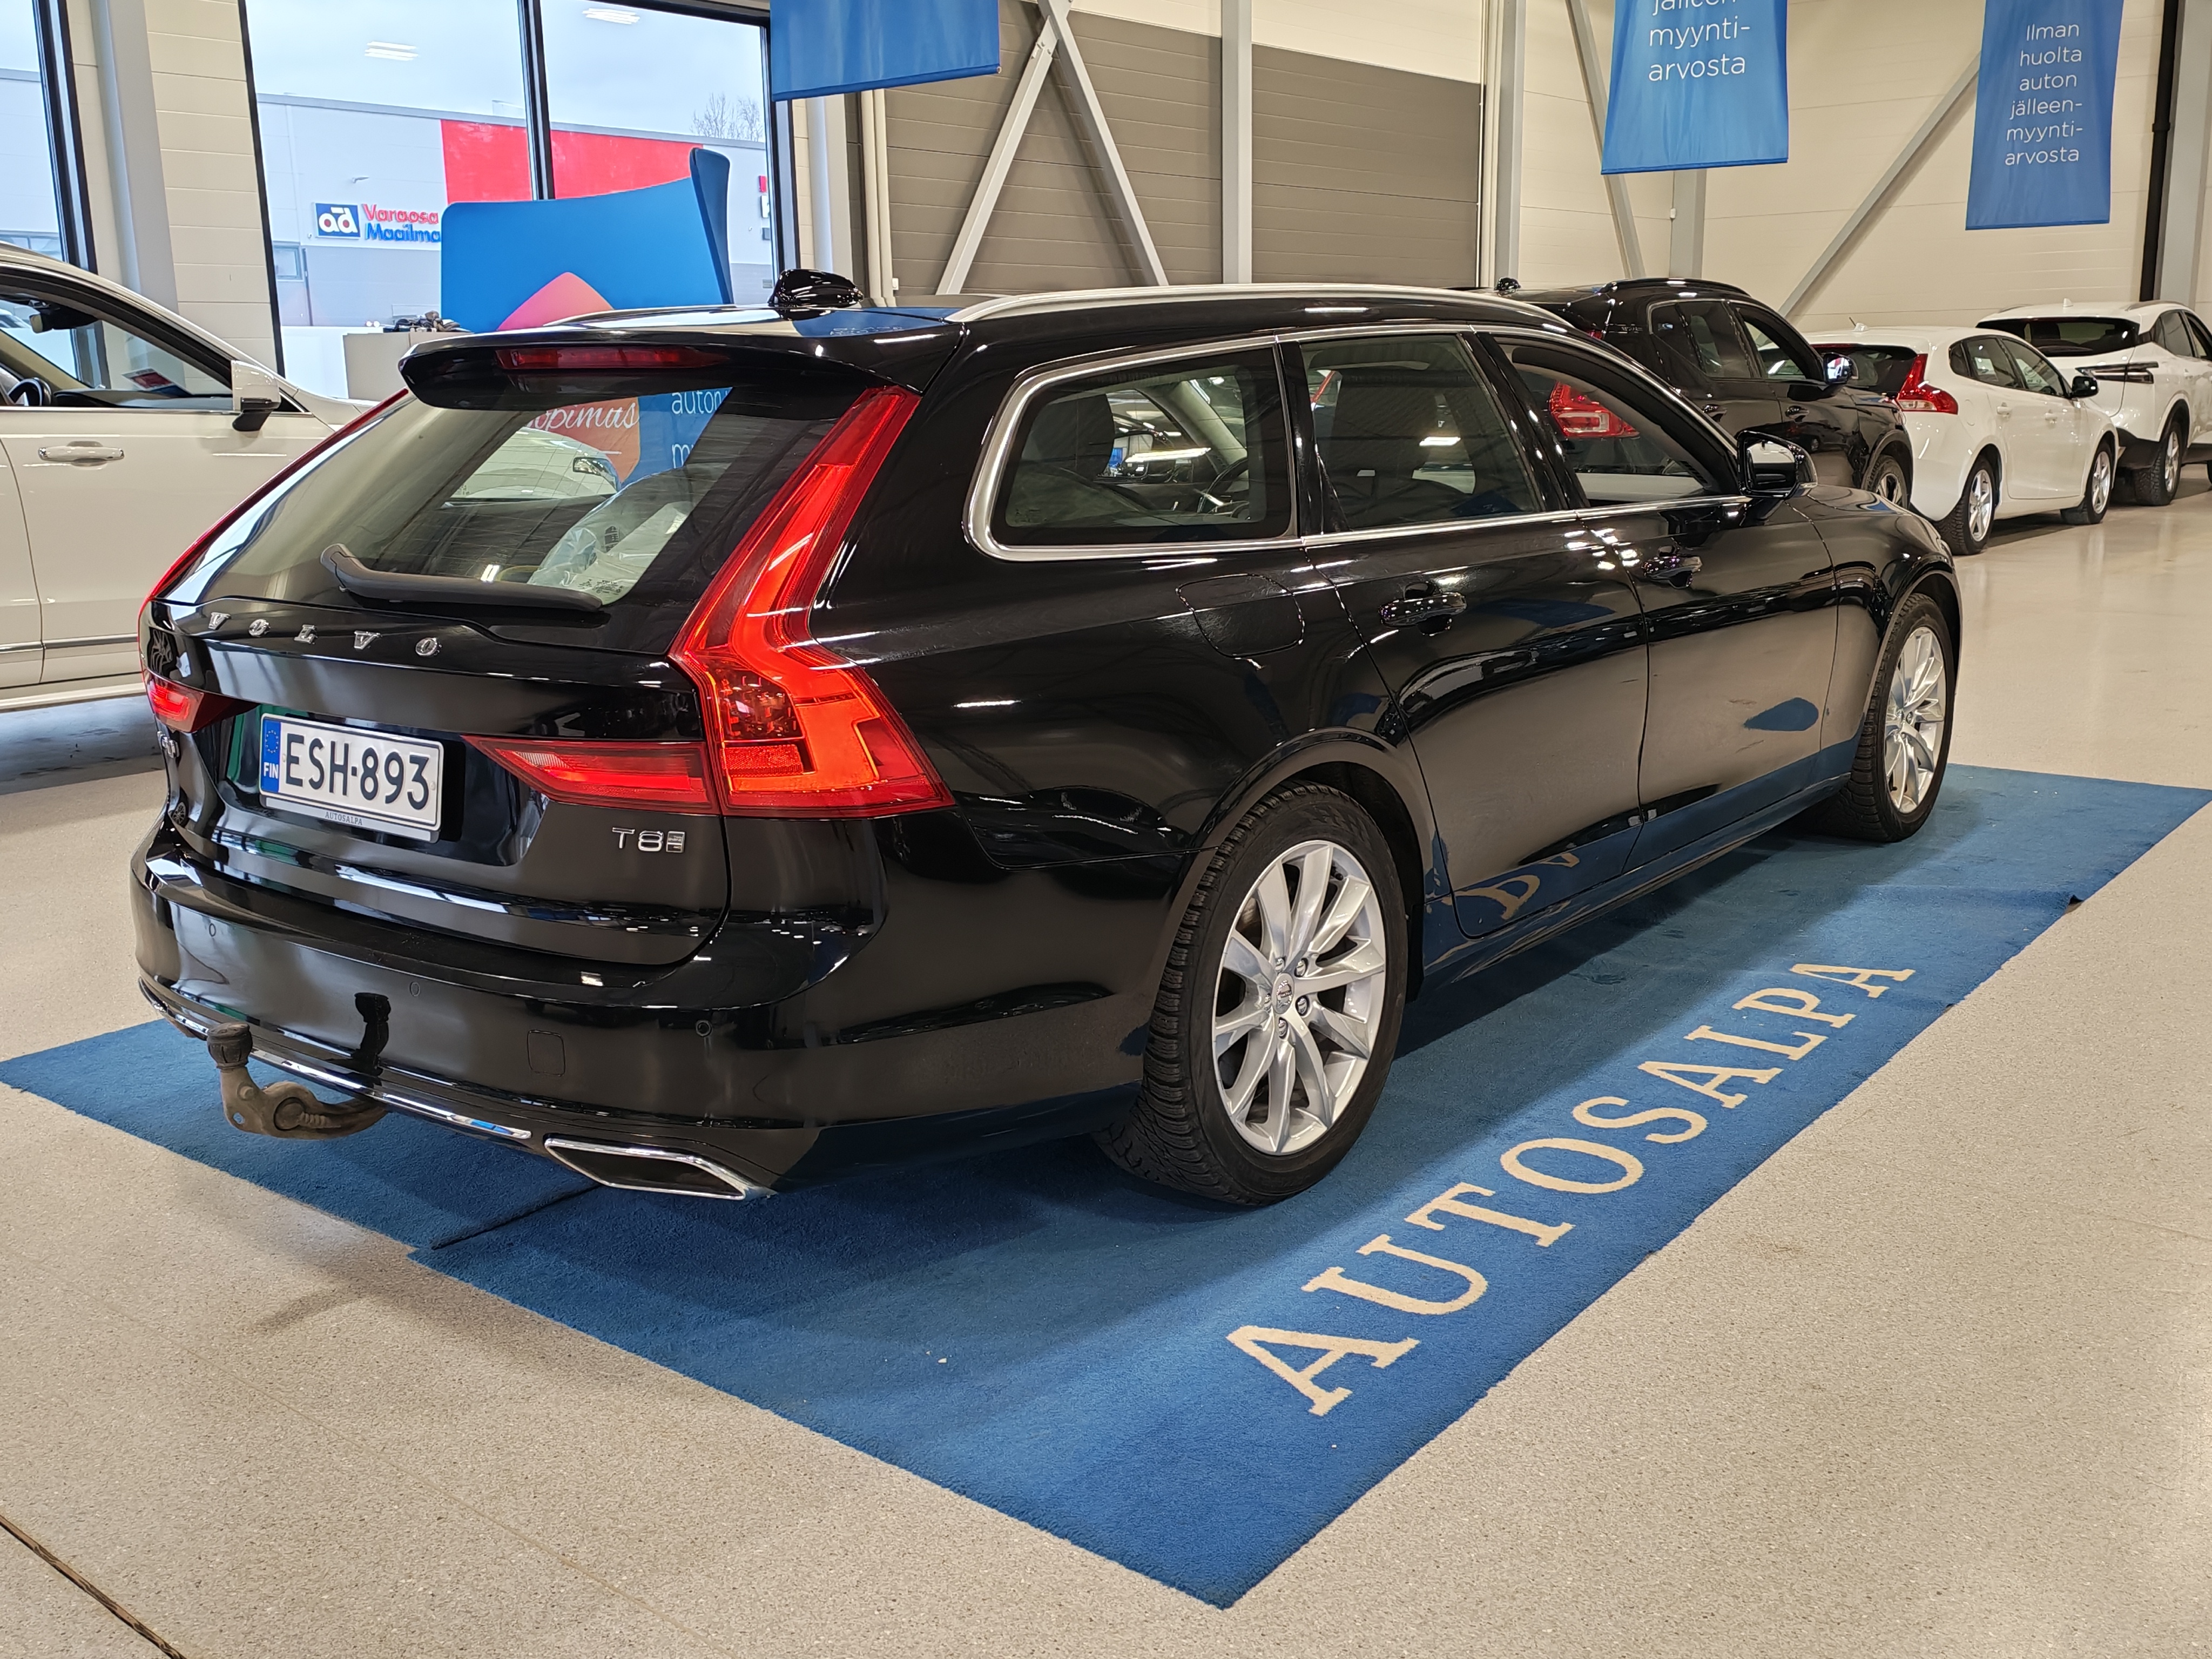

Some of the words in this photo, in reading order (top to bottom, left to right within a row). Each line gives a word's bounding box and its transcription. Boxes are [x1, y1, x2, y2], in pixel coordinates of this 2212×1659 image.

[1649, 15, 1751, 49] myynti-
[2026, 23, 2079, 41] Ilman
[2020, 45, 2082, 66] huolta
[1648, 53, 1745, 82] arvosta
[2019, 73, 2077, 91] auton
[2009, 98, 2082, 120] jälleen-
[2006, 120, 2083, 143] myynti-
[2005, 146, 2079, 165] arvosta
[363, 204, 439, 224] Varaosa
[365, 222, 441, 242] Maailma
[208, 612, 442, 657] VOLVO
[263, 761, 279, 779] FIN
[286, 732, 429, 810] ESH-893
[325, 811, 363, 826] AUTOSALPA
[612, 827, 664, 852] T8
[1226, 962, 1916, 1416] AUTOSALPA
